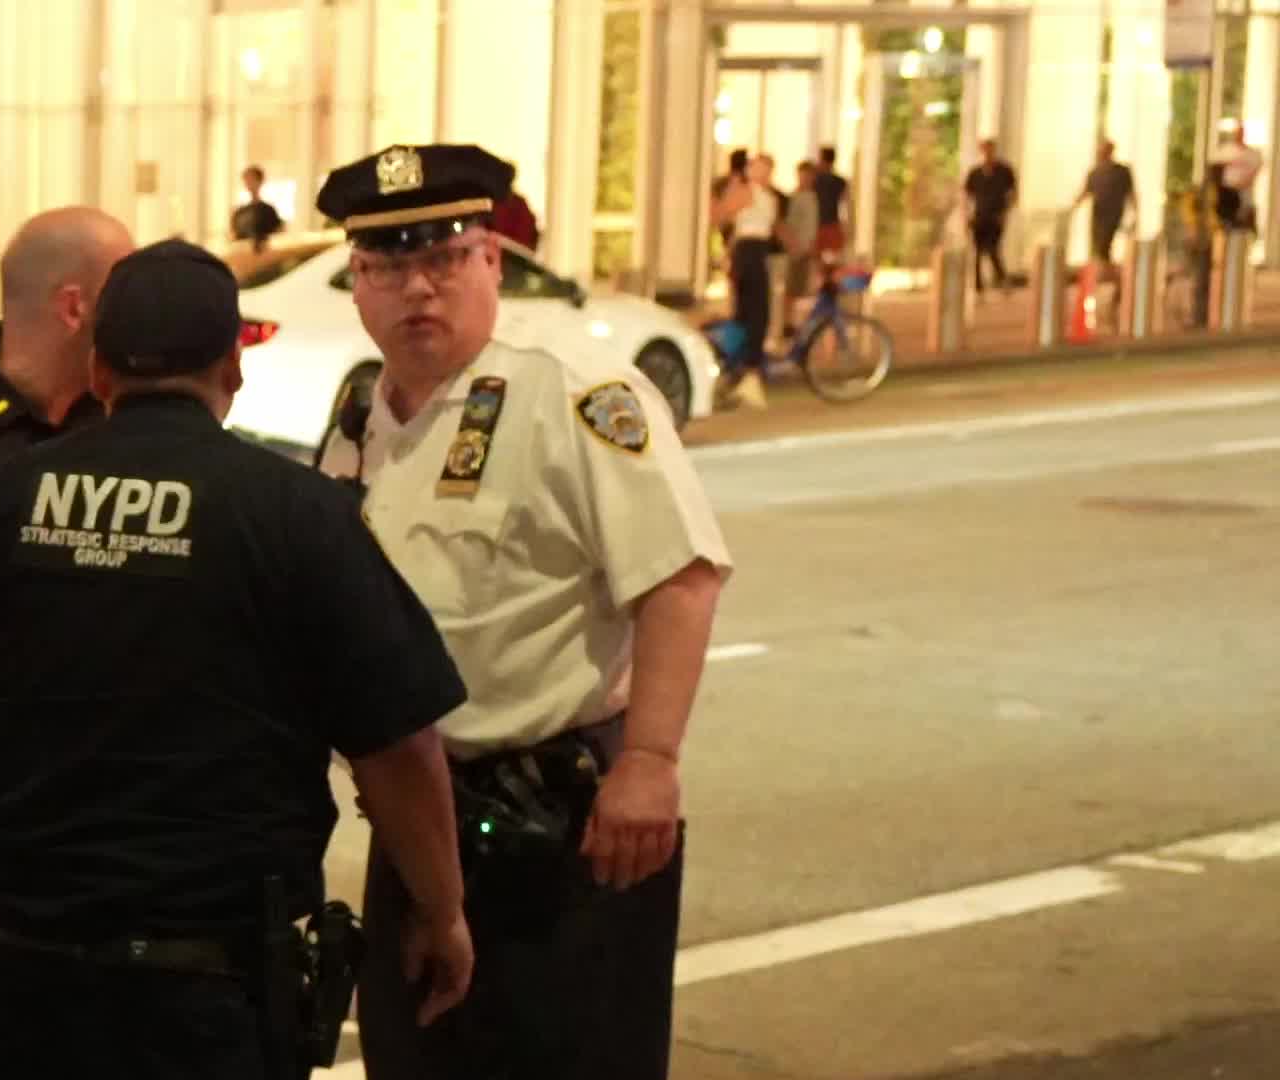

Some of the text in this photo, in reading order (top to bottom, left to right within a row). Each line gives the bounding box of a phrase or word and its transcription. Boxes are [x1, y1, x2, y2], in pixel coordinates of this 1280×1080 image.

[31, 473, 192, 535] NYPD
[20, 526, 192, 556] STRATEGIC RESPONSE
[74, 549, 128, 567] GROUP
